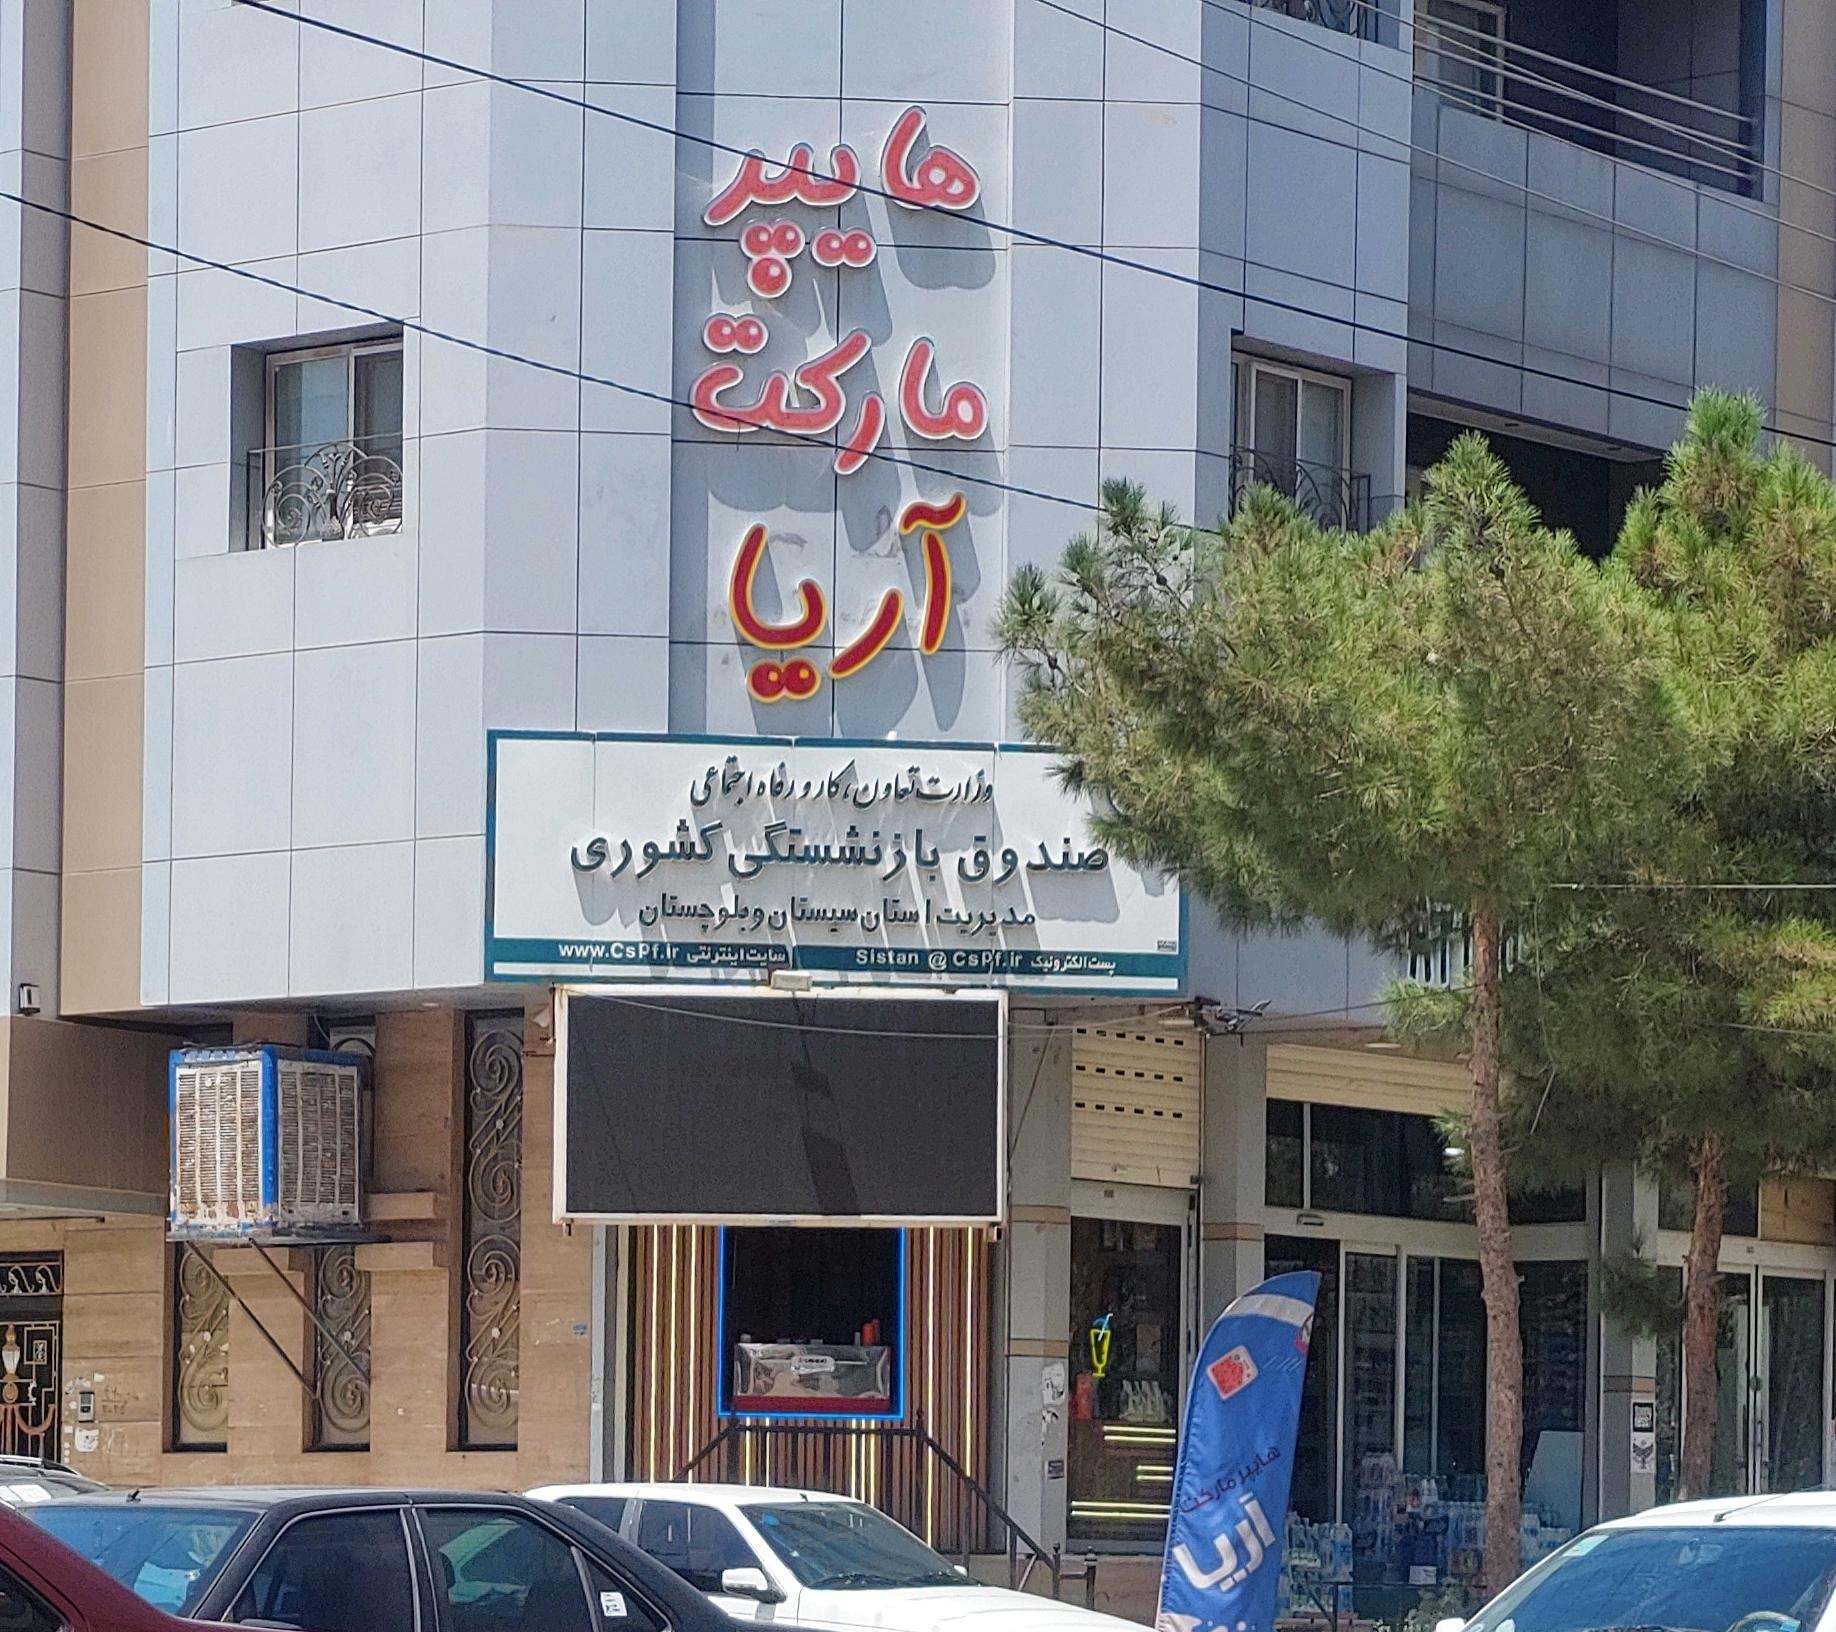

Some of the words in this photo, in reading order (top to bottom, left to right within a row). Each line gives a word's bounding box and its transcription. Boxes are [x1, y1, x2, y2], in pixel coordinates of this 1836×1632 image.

[704, 104, 981, 298] هایپر
[690, 313, 988, 476] مارکت
[729, 492, 966, 702] آریا
[689, 754, 752, 808] اجتماعی
[916, 768, 995, 805] وزارت
[570, 818, 723, 880] کشوری
[728, 819, 940, 883] بازنشستگی
[957, 836, 1109, 885] صندوق
[768, 896, 859, 933] سیستان
[859, 898, 931, 932] استان
[935, 905, 1037, 937] مدیریت
[686, 945, 744, 967] اینترنتی
[746, 945, 786, 967] سایت
[1030, 955, 1087, 973] الکترونیک
[1087, 955, 1117, 976] پست
[1172, 1491, 1276, 1593] آریا
